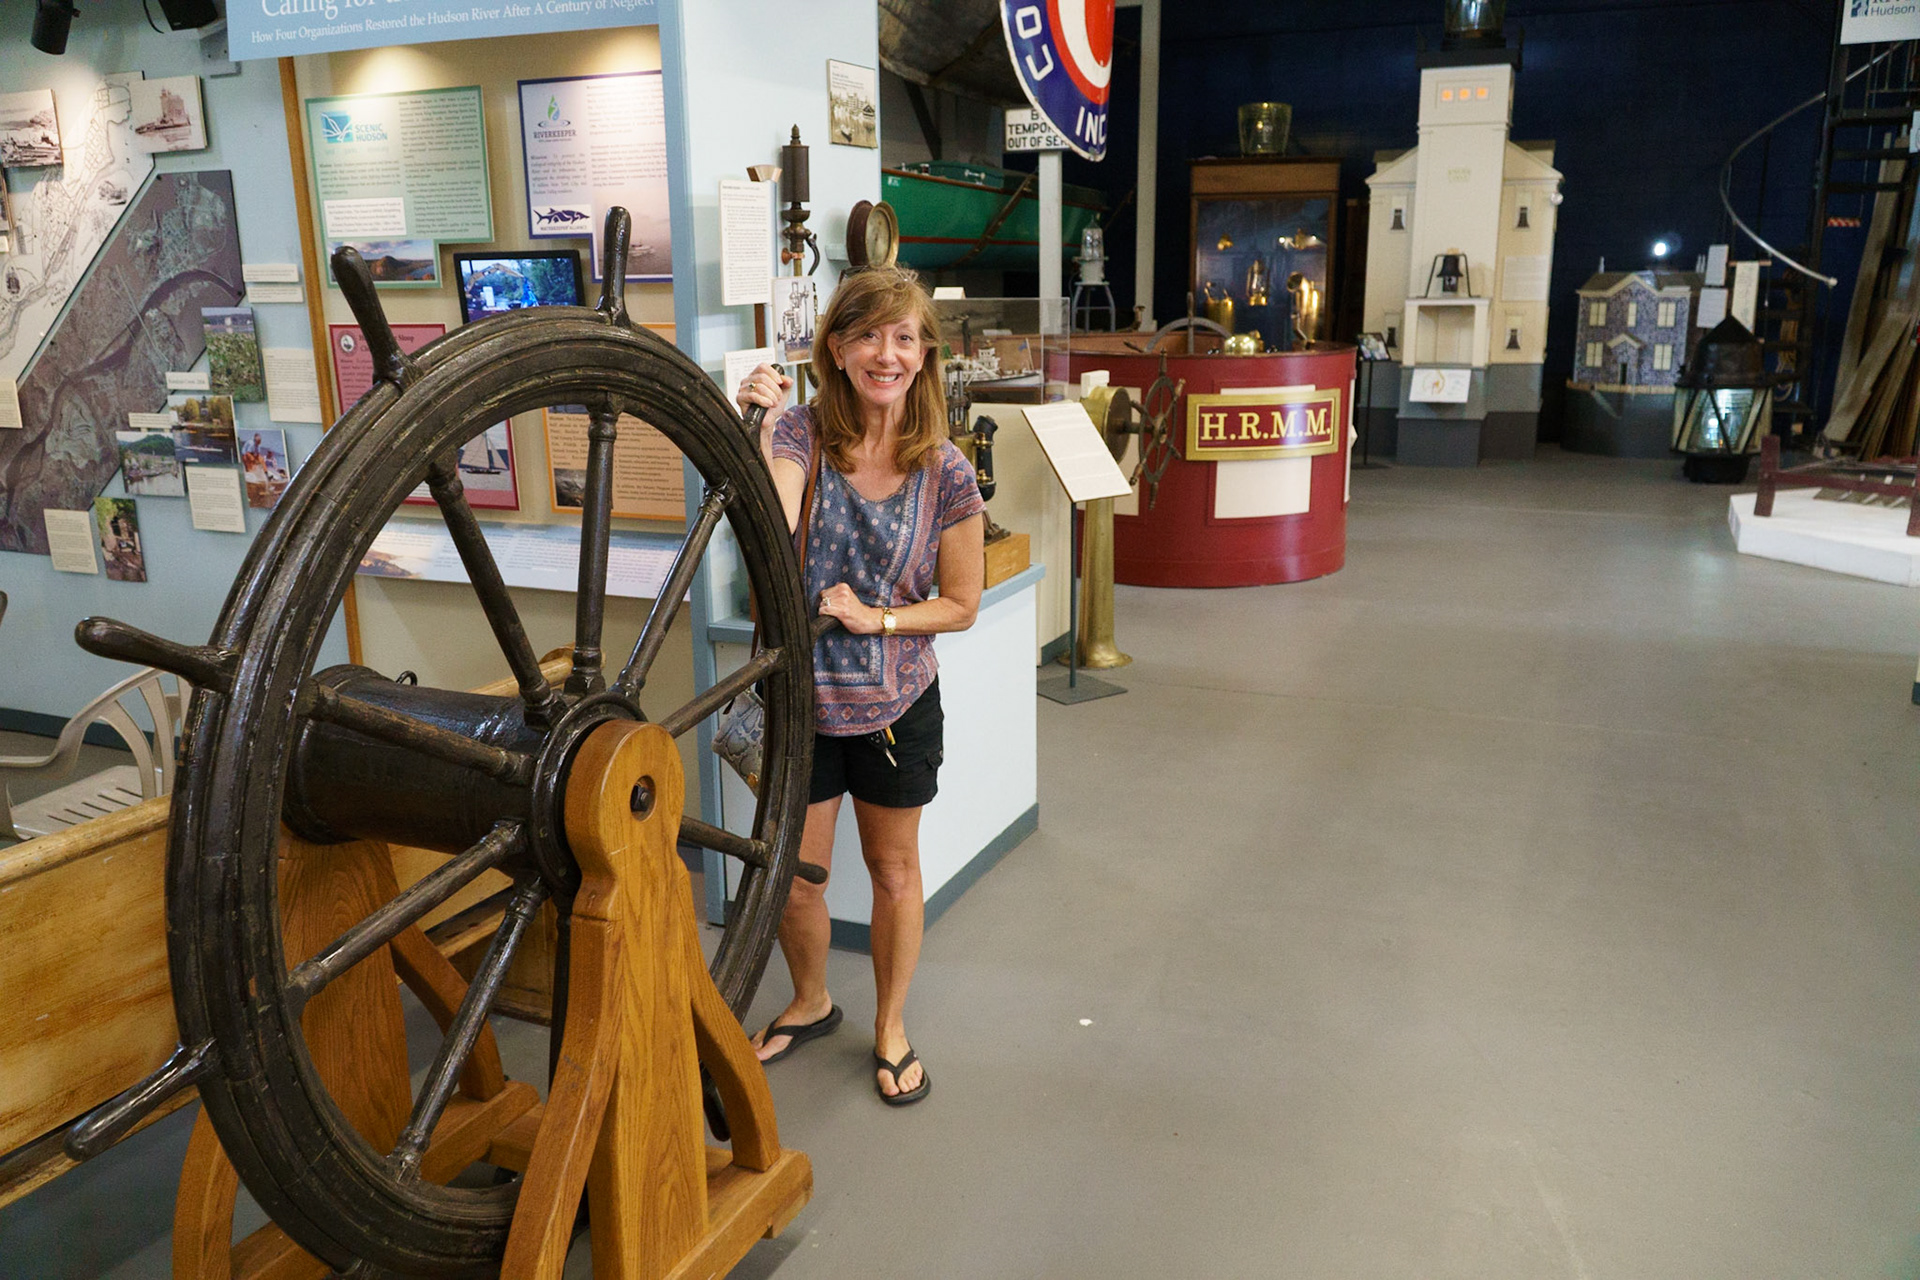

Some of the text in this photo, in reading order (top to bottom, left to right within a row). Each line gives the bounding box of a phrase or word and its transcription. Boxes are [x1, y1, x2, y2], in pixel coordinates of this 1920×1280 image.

[1870, 5, 1915, 16] Hudson
[251, 31, 273, 43] How
[275, 28, 297, 41] Four
[298, 23, 363, 41] Organizations
[365, 15, 408, 32] Restored
[409, 12, 427, 25] the
[428, 10, 469, 25] Hudson
[471, 7, 500, 21] River
[502, 4, 531, 18] After
[534, 3, 544, 15] A
[546, 0, 592, 15] Century
[355, 123, 383, 133] SCENIC
[356, 132, 388, 142] HUDSON
[533, 129, 577, 139] RIVERKEEPER
[1008, 137, 1028, 148] OUT
[1030, 136, 1043, 147] OF
[1200, 408, 1331, 441] H.R.M.M.
